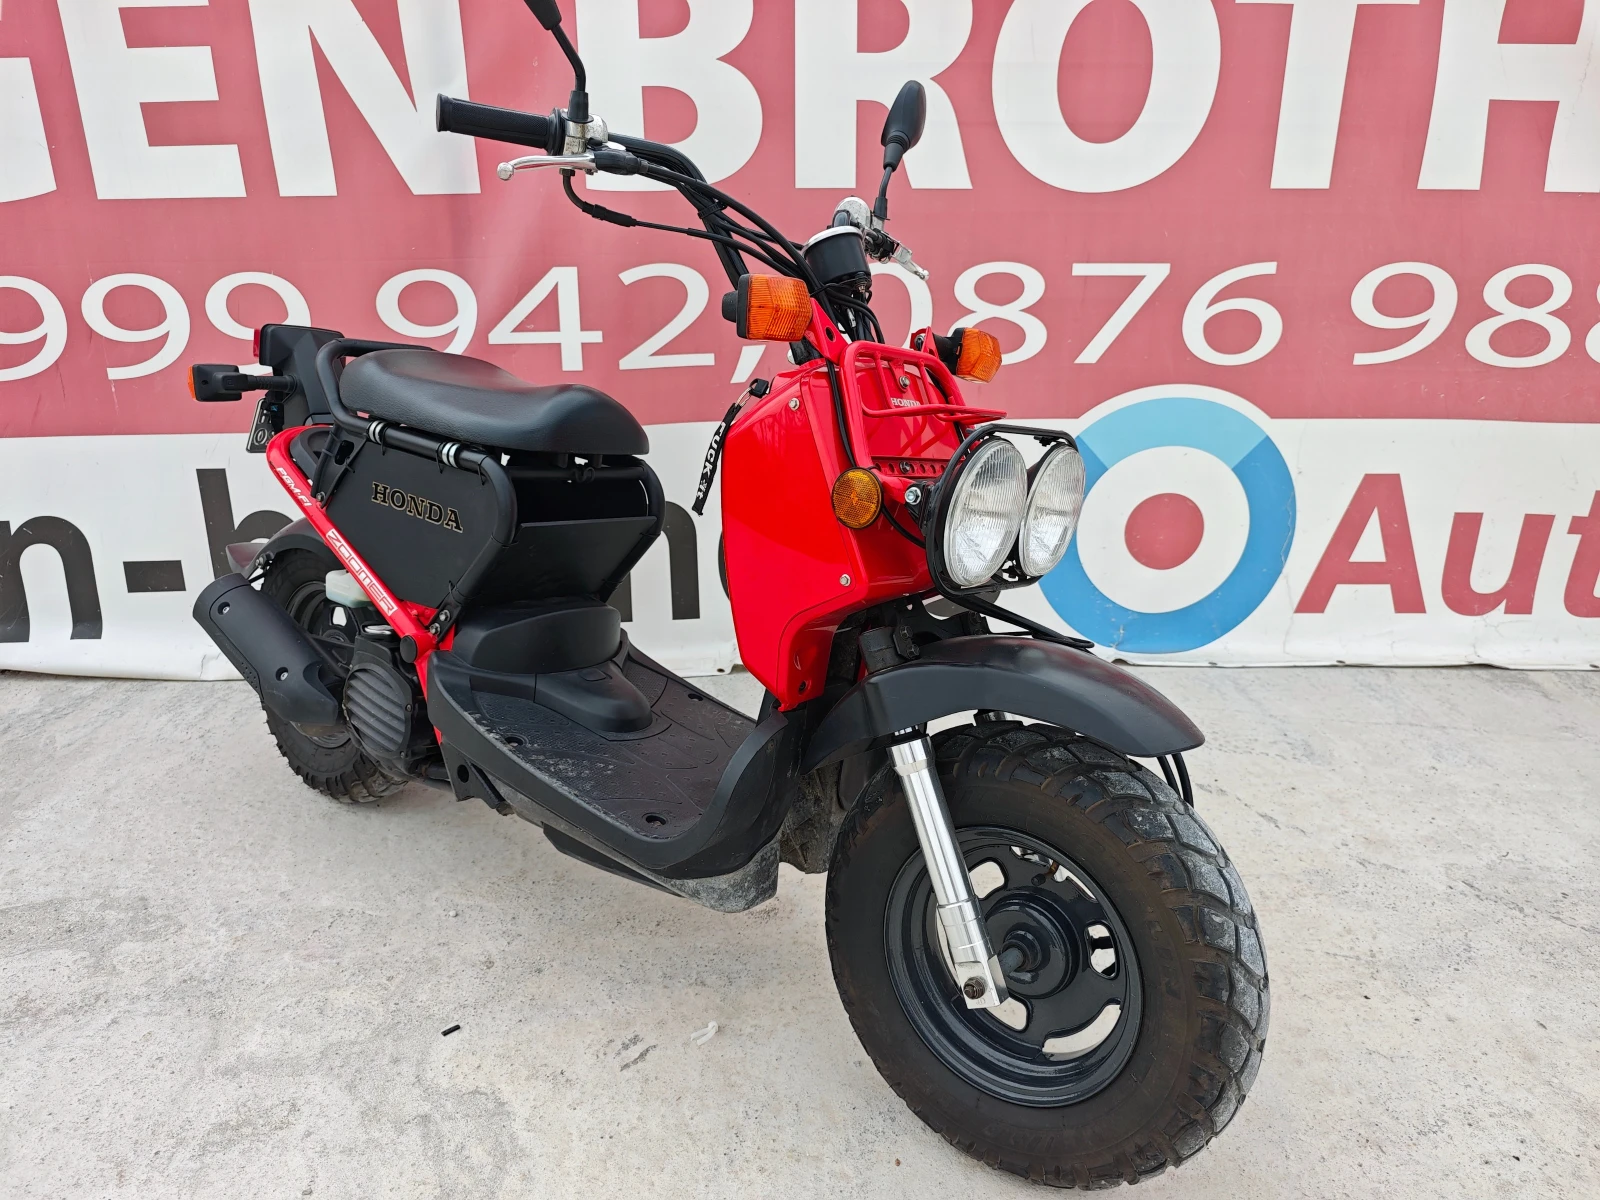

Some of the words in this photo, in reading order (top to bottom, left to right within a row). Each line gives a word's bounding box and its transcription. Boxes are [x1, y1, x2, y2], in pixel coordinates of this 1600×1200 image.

[575, 0, 1600, 193] BROTH
[376, 262, 767, 384] 942,
[1350, 261, 1600, 368] 98
[371, 481, 464, 533] HONDA
[326, 529, 397, 616] ZOOMER
